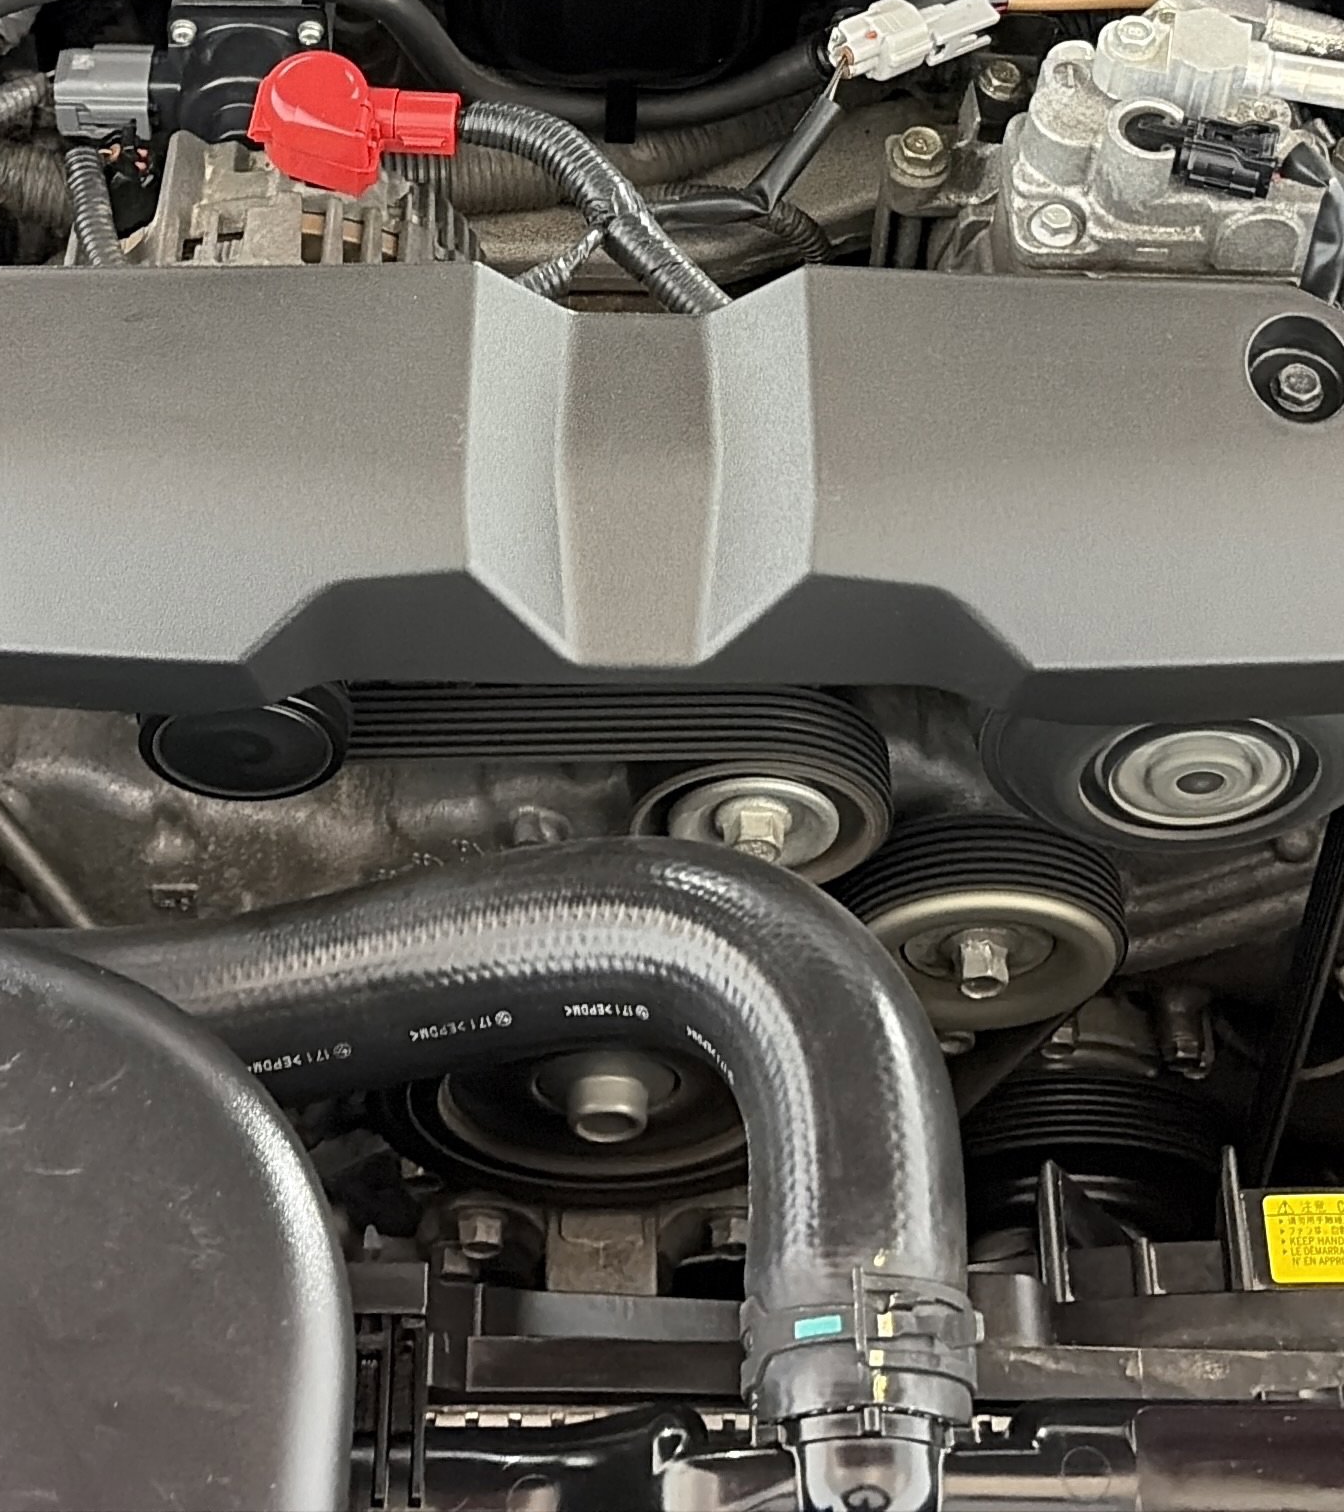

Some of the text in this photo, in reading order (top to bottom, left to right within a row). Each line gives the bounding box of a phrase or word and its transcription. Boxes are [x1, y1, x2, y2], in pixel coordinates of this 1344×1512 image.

[1289, 1236, 1314, 1245] KEEP
[1291, 1248, 1302, 1256] LE
[1303, 1257, 1316, 1265] EN
